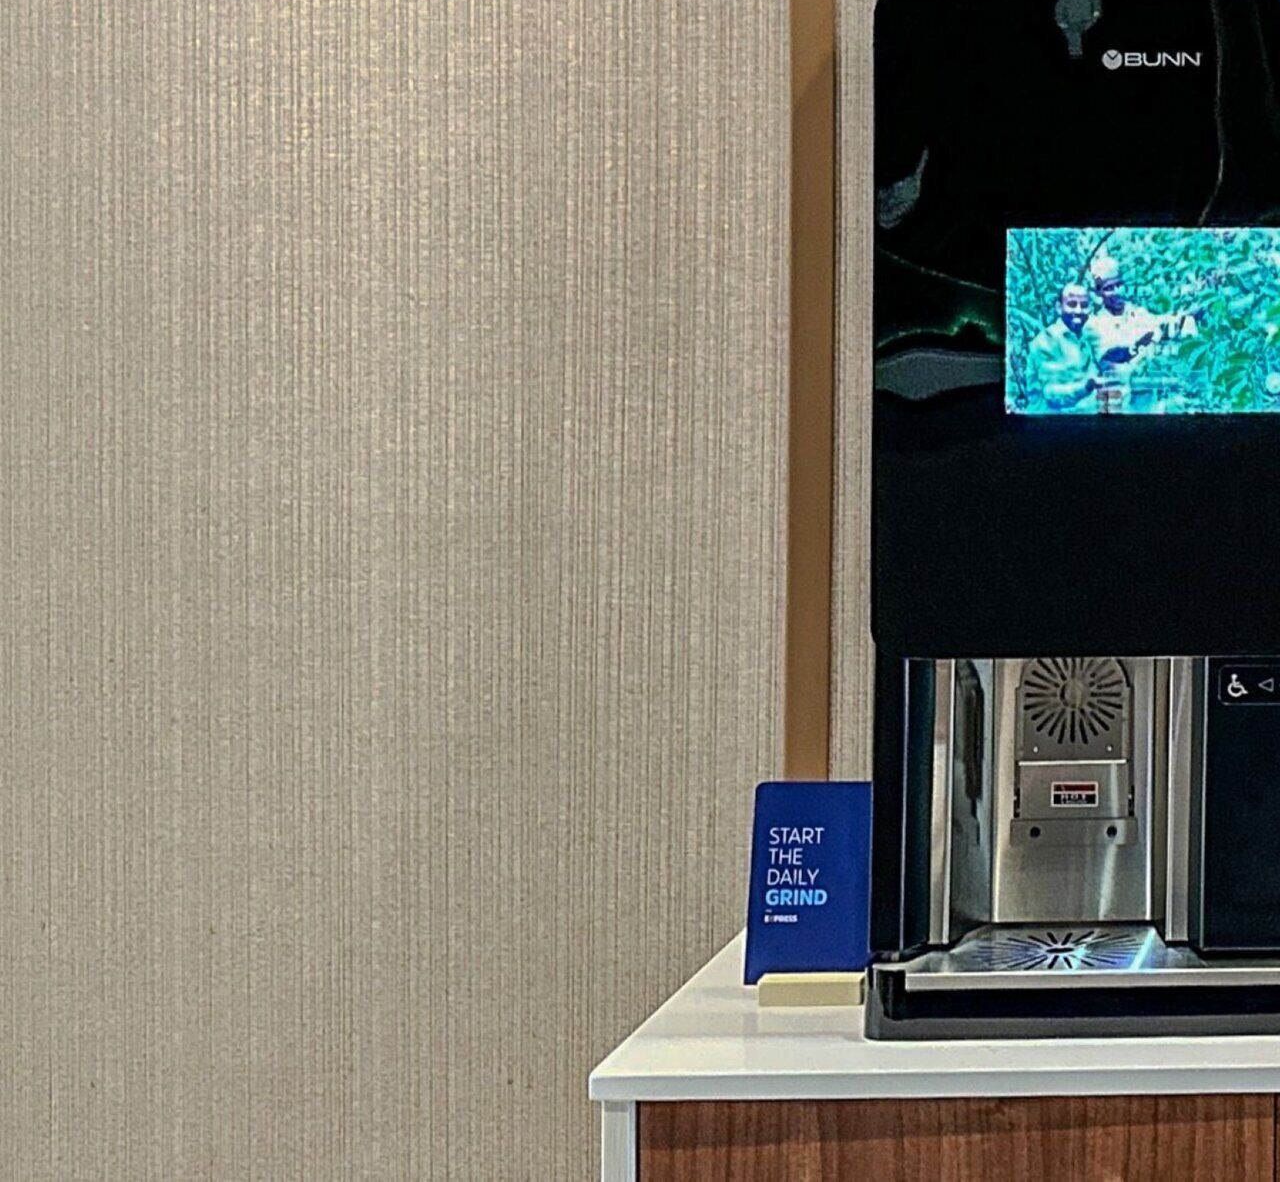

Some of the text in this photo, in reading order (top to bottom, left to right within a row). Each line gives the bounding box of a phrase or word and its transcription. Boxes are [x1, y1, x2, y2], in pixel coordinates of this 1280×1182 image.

[1124, 52, 1201, 67] BUNN
[768, 827, 825, 845] START
[768, 847, 803, 865] THE
[766, 868, 820, 886] DAILY
[765, 888, 828, 906] GRIND
